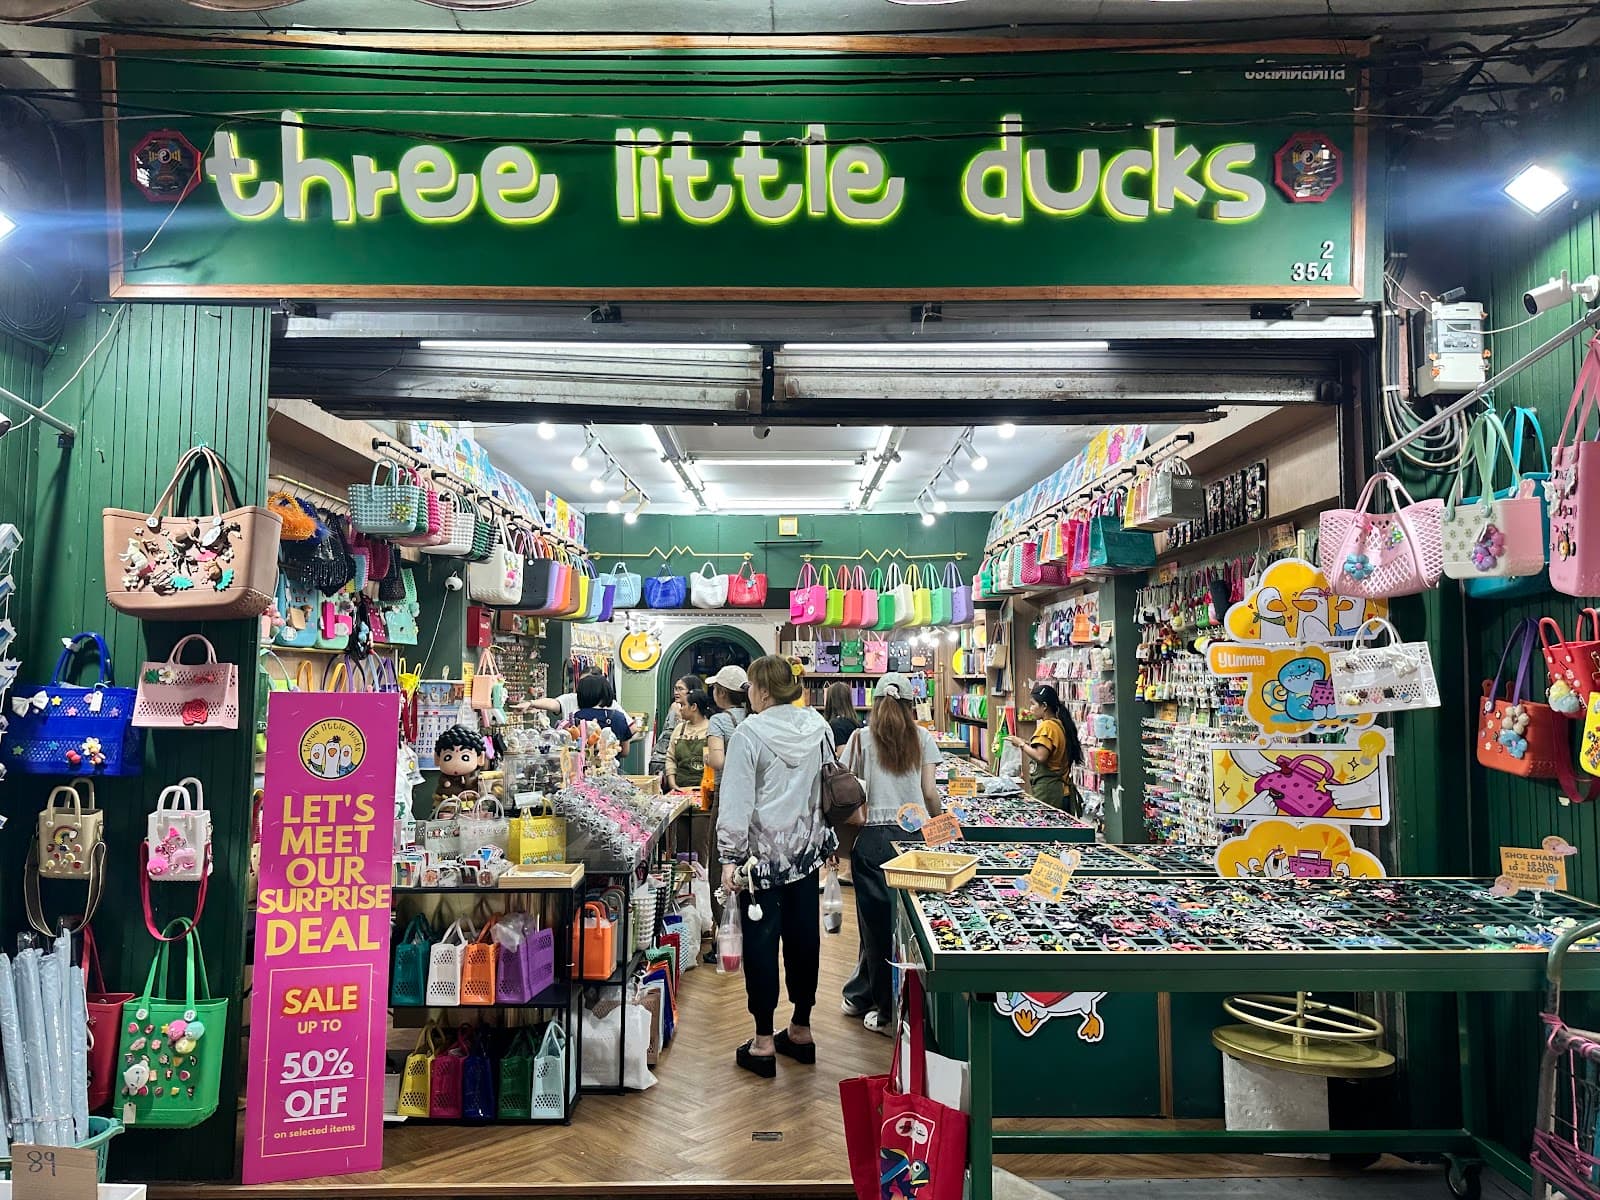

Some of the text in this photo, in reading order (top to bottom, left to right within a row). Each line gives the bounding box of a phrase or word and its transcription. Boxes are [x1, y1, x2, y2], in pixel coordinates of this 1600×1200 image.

[205, 110, 1267, 224] three little ducks
[1320, 240, 1334, 259] 2
[1291, 262, 1333, 281] 354
[283, 794, 375, 823] LET'S
[280, 825, 375, 855] MEET
[286, 856, 366, 887] OUR
[1504, 852, 1563, 862] SHOE CHARM
[257, 884, 390, 914] SURPRISE
[266, 915, 380, 956] DEAL
[283, 985, 358, 1015] SALE
[297, 1019, 342, 1034] UP TO
[281, 1047, 354, 1080] 50%
[285, 1086, 348, 1118] OFF
[274, 1124, 356, 1139] on selected items
[26, 1150, 57, 1177] 89
